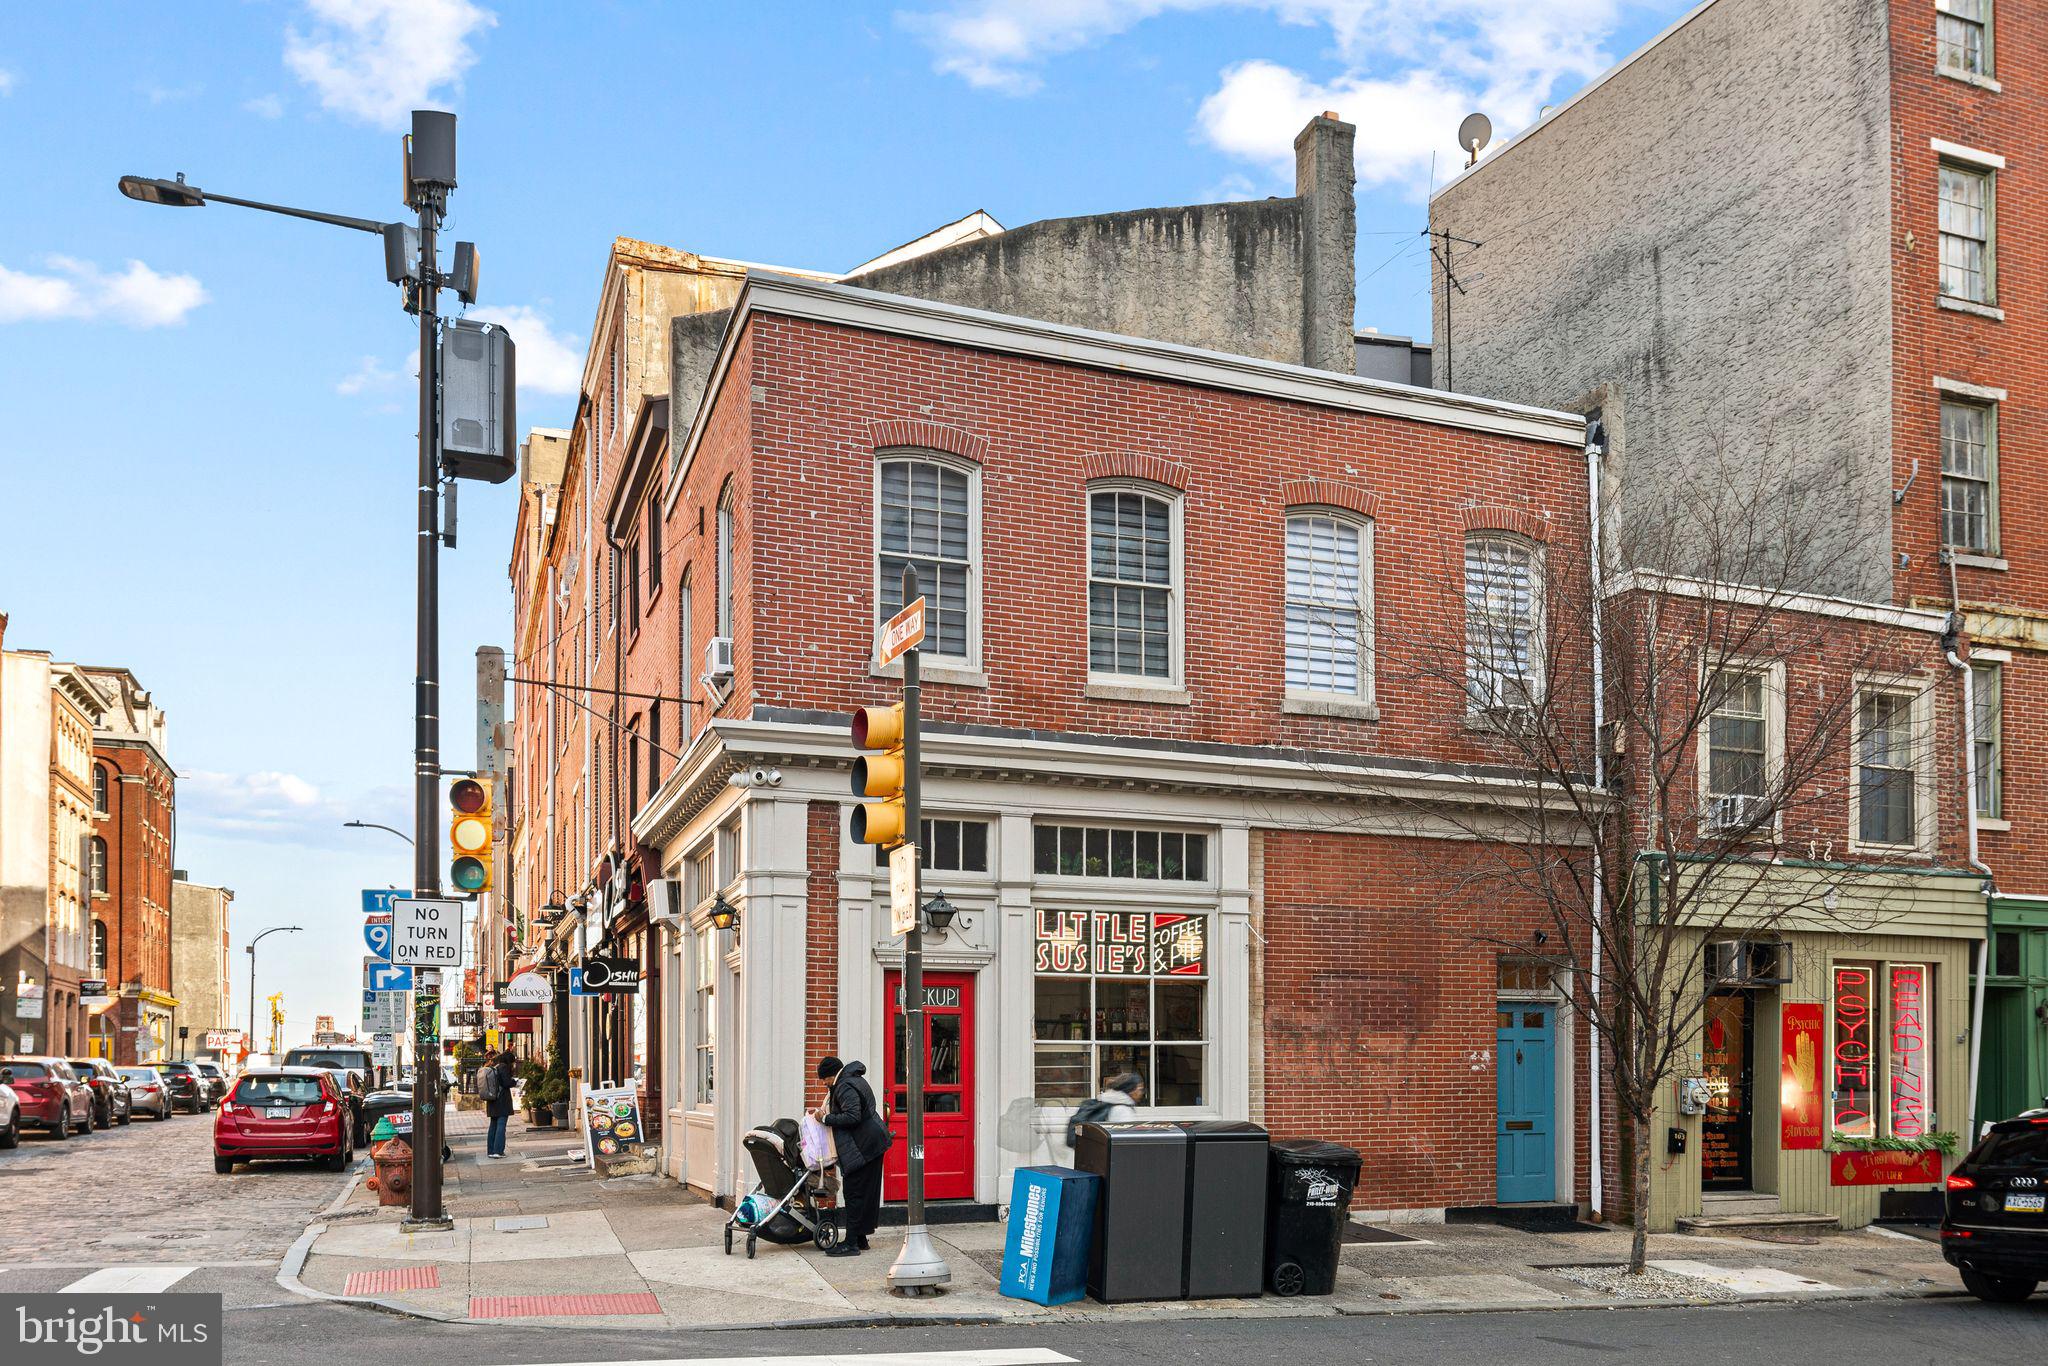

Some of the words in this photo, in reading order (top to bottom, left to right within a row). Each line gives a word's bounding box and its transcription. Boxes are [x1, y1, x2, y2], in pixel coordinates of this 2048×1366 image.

[892, 624, 903, 646] ONE
[905, 612, 920, 637] WAY
[415, 908, 439, 920] NO
[1036, 910, 1146, 943] LITTLE
[369, 926, 388, 952] 9
[407, 926, 447, 939] TURN
[1153, 916, 1203, 948] COFFEE
[398, 944, 418, 957] ON
[426, 946, 455, 958] RED
[1036, 942, 1146, 973] SUSIE'S
[1153, 948, 1168, 973] &
[1170, 938, 1201, 968] PIE
[900, 988, 956, 1005] KUP
[1787, 1016, 1820, 1030] PSYCHIC
[1836, 971, 1869, 1133] PSYCHIC
[1892, 970, 1923, 1137] READINGS
[1785, 1125, 1820, 1138] ADVISOR
[1019, 1184, 1041, 1257] Milestones
[1033, 1224, 1042, 1261] POSSIBILITIES
[1039, 1188, 1047, 1211] SENIORS
[1018, 1261, 1027, 1283] PCA
